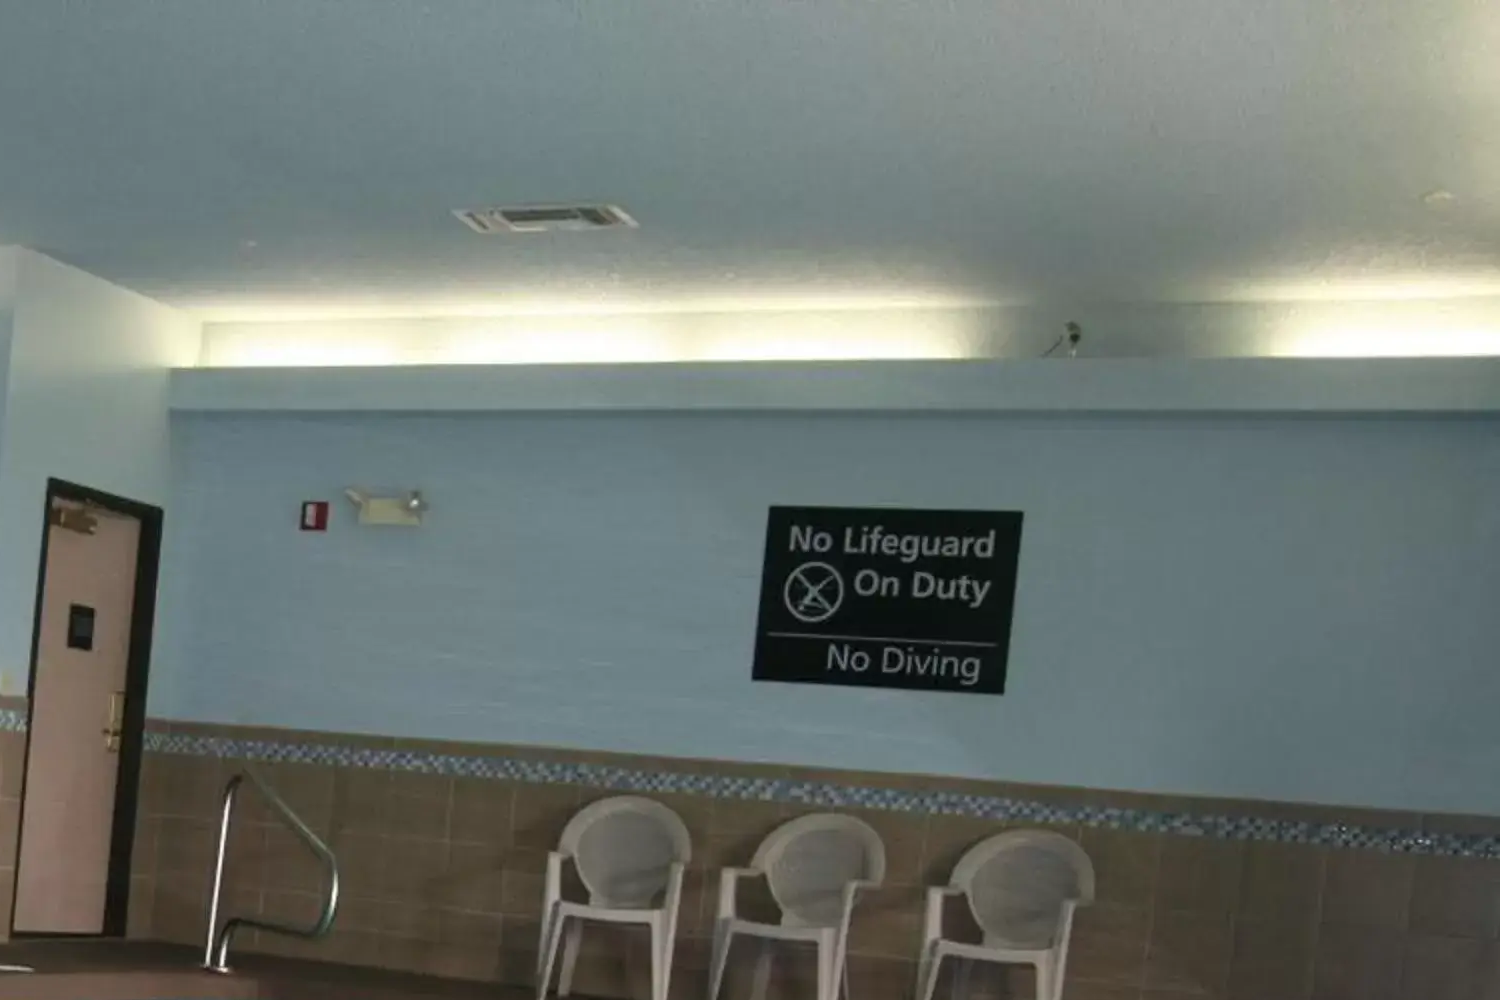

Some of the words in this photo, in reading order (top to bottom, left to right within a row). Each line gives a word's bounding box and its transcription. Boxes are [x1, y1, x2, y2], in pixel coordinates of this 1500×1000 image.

[789, 525, 834, 552] No
[844, 526, 997, 563] Lifeguard
[854, 569, 899, 597] On
[912, 571, 991, 608] Duty
[827, 644, 871, 672] No
[881, 646, 981, 685] Diving
